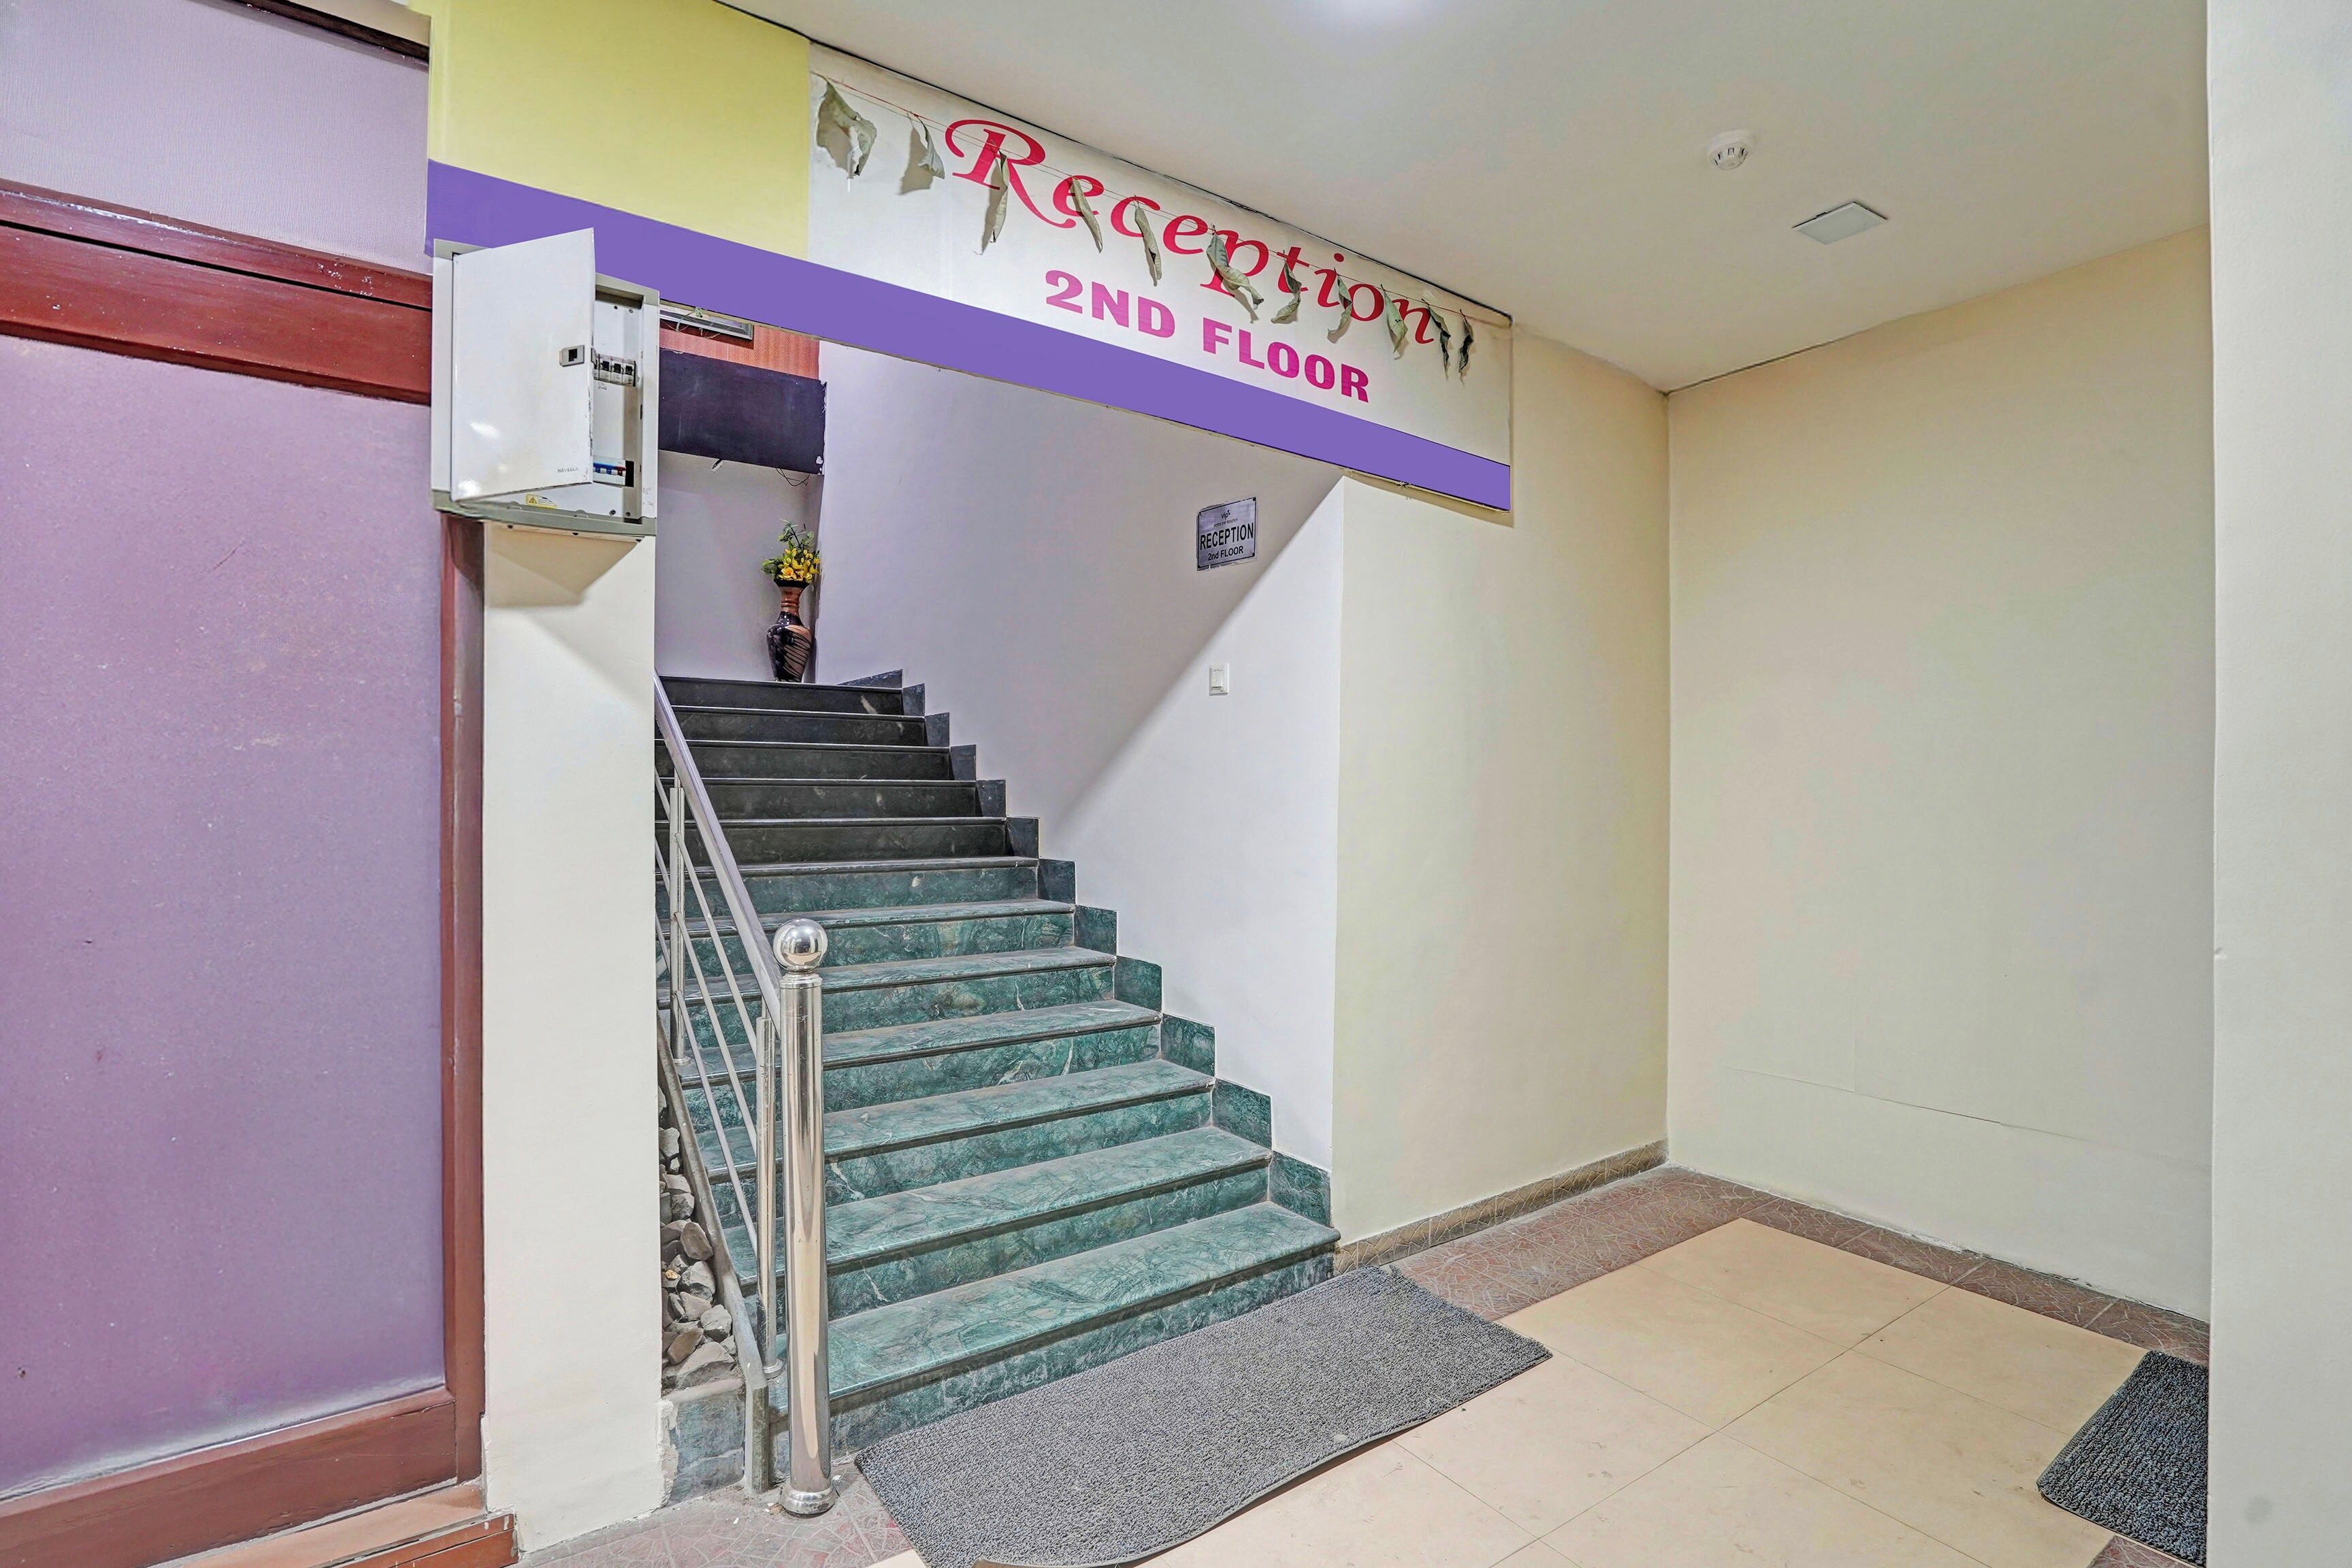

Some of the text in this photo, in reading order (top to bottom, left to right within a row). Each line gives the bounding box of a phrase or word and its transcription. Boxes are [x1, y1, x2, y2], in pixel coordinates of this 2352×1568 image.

[945, 119, 1434, 344] Reception
[1045, 270, 1369, 403] 2ND FLOOR
[1200, 523, 1254, 550] RECEPTION
[1208, 546, 1243, 561] 2nd FLOOR
